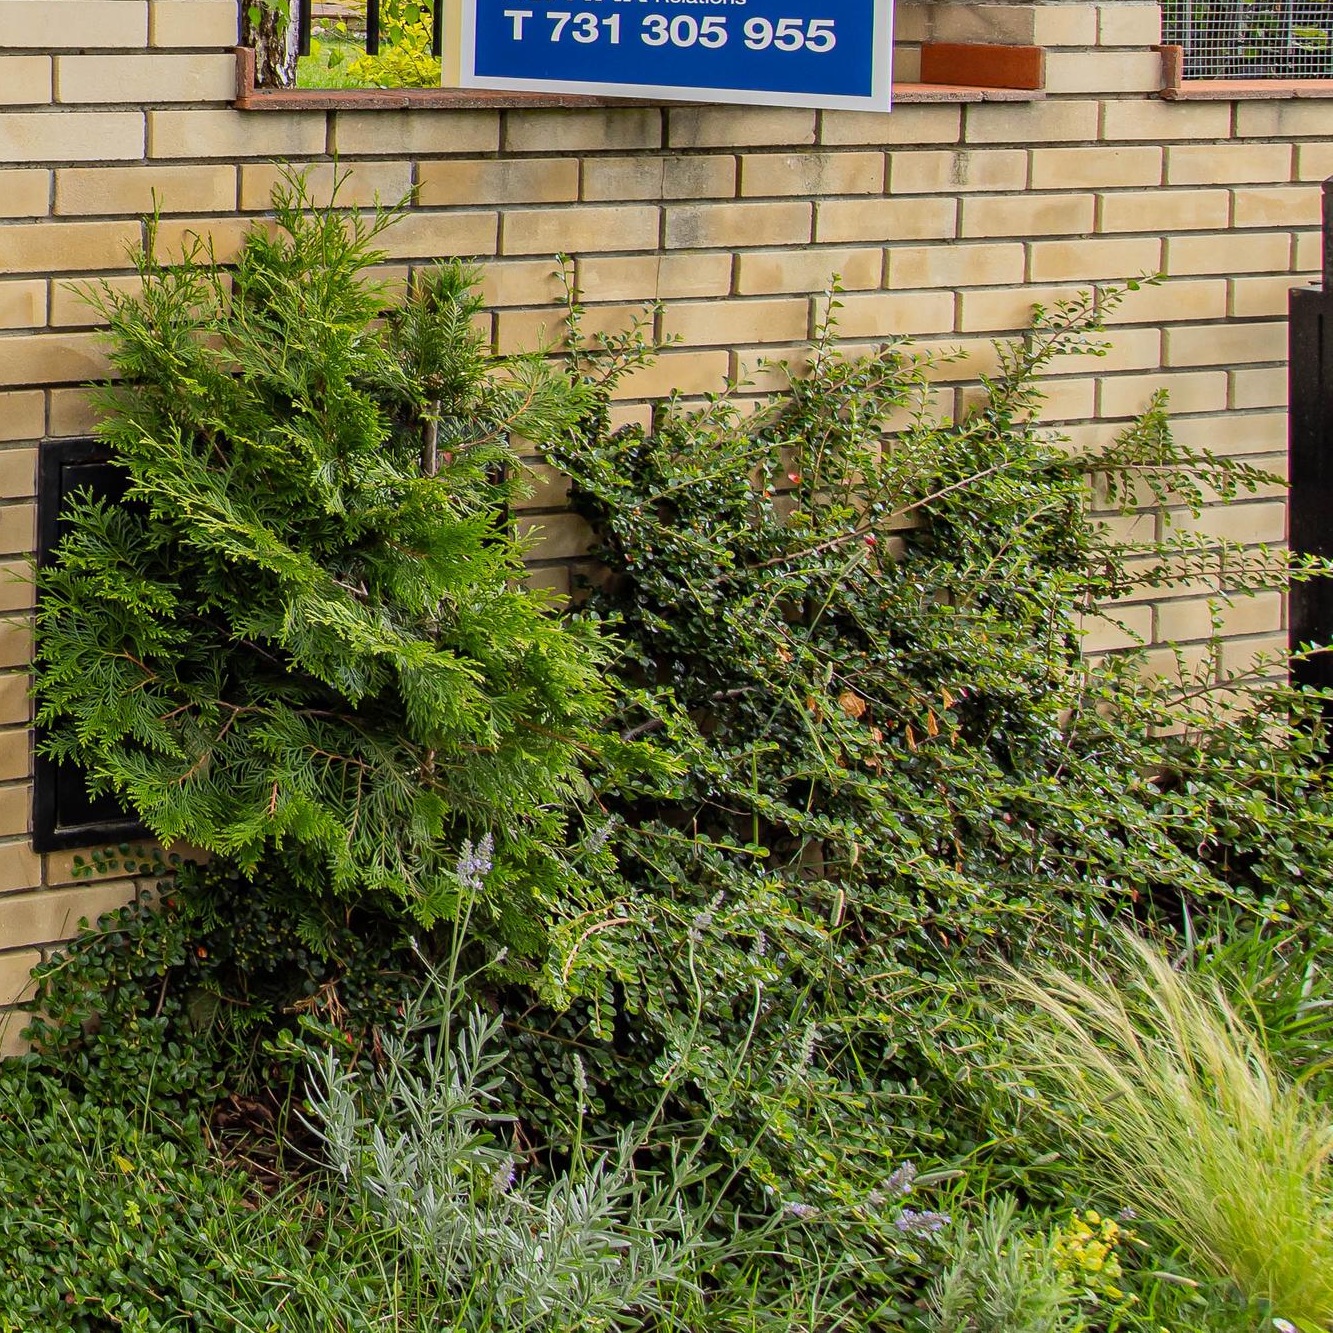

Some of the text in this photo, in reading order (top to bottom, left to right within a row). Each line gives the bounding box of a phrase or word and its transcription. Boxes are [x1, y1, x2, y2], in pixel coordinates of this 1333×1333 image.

[503, 9, 837, 53] T 731 305 955
